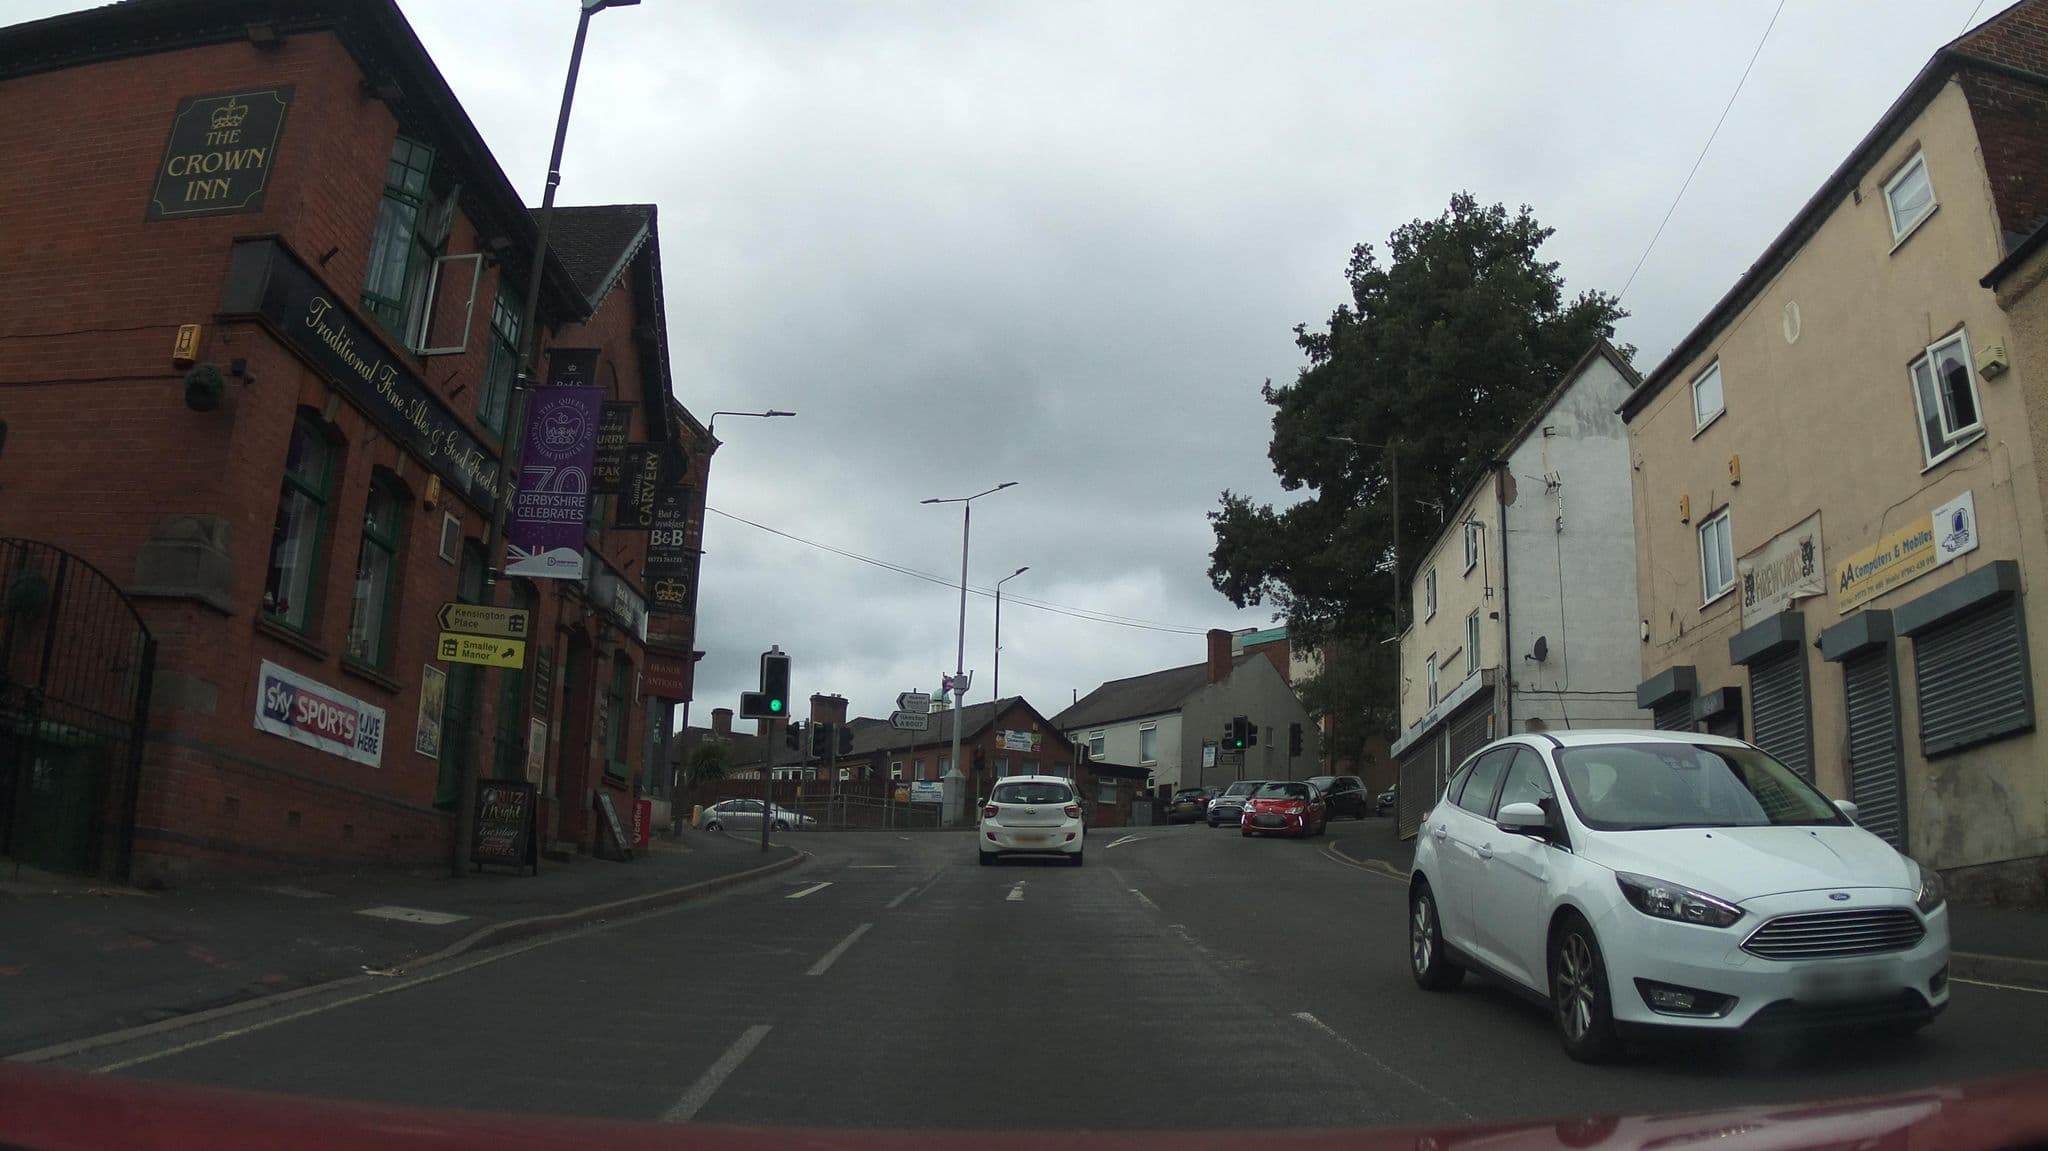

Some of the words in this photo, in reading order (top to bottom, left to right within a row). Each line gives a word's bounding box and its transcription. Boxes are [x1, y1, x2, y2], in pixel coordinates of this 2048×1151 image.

[206, 129, 241, 146] THE
[167, 148, 266, 177] CROWN
[184, 178, 231, 201] INN
[305, 296, 380, 384] Traditional
[376, 364, 404, 412] Fine
[405, 399, 430, 436] Ales
[429, 423, 444, 456] &
[444, 431, 471, 473] Good
[596, 434, 625, 444] URRY
[522, 465, 587, 494] 70
[593, 466, 621, 476] TEAK
[639, 450, 659, 525] CARVERY
[519, 494, 586, 507] DERBYSHIRE
[517, 506, 584, 520] CELEBRATES
[650, 529, 684, 546] B&B
[1840, 563, 1854, 593] AA
[1855, 552, 1892, 579] Computers
[1894, 545, 1900, 558] &
[1903, 530, 1932, 553] Mobiles
[454, 618, 479, 628] Place
[455, 608, 505, 621] Kensington
[462, 650, 490, 660] Manor
[463, 641, 499, 653] Smalley
[266, 683, 293, 721] sky
[296, 695, 355, 740] SPORTS
[359, 713, 380, 737] LIVE
[357, 735, 378, 755] HERE
